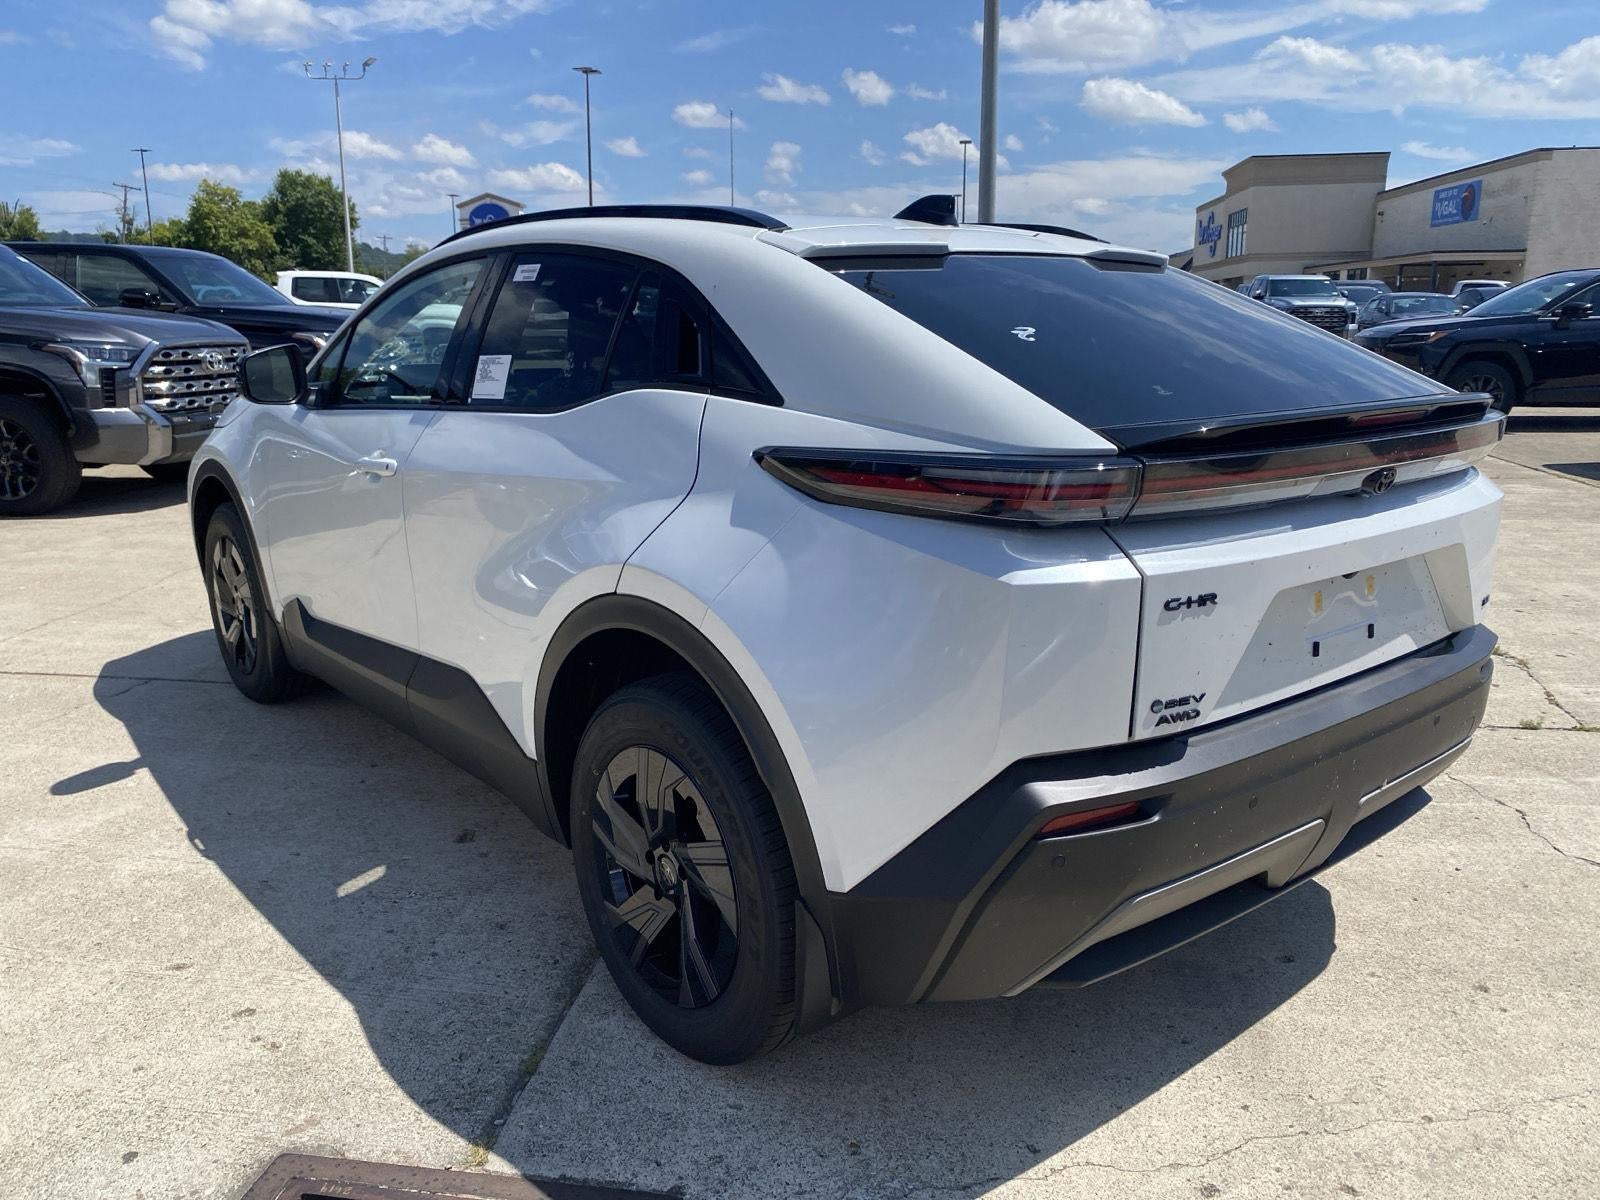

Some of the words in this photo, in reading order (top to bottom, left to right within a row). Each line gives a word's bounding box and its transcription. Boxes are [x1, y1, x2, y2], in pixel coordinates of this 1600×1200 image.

[1163, 592, 1218, 611] C-HR
[1164, 692, 1206, 710] BEV
[1155, 708, 1201, 727] AWD
